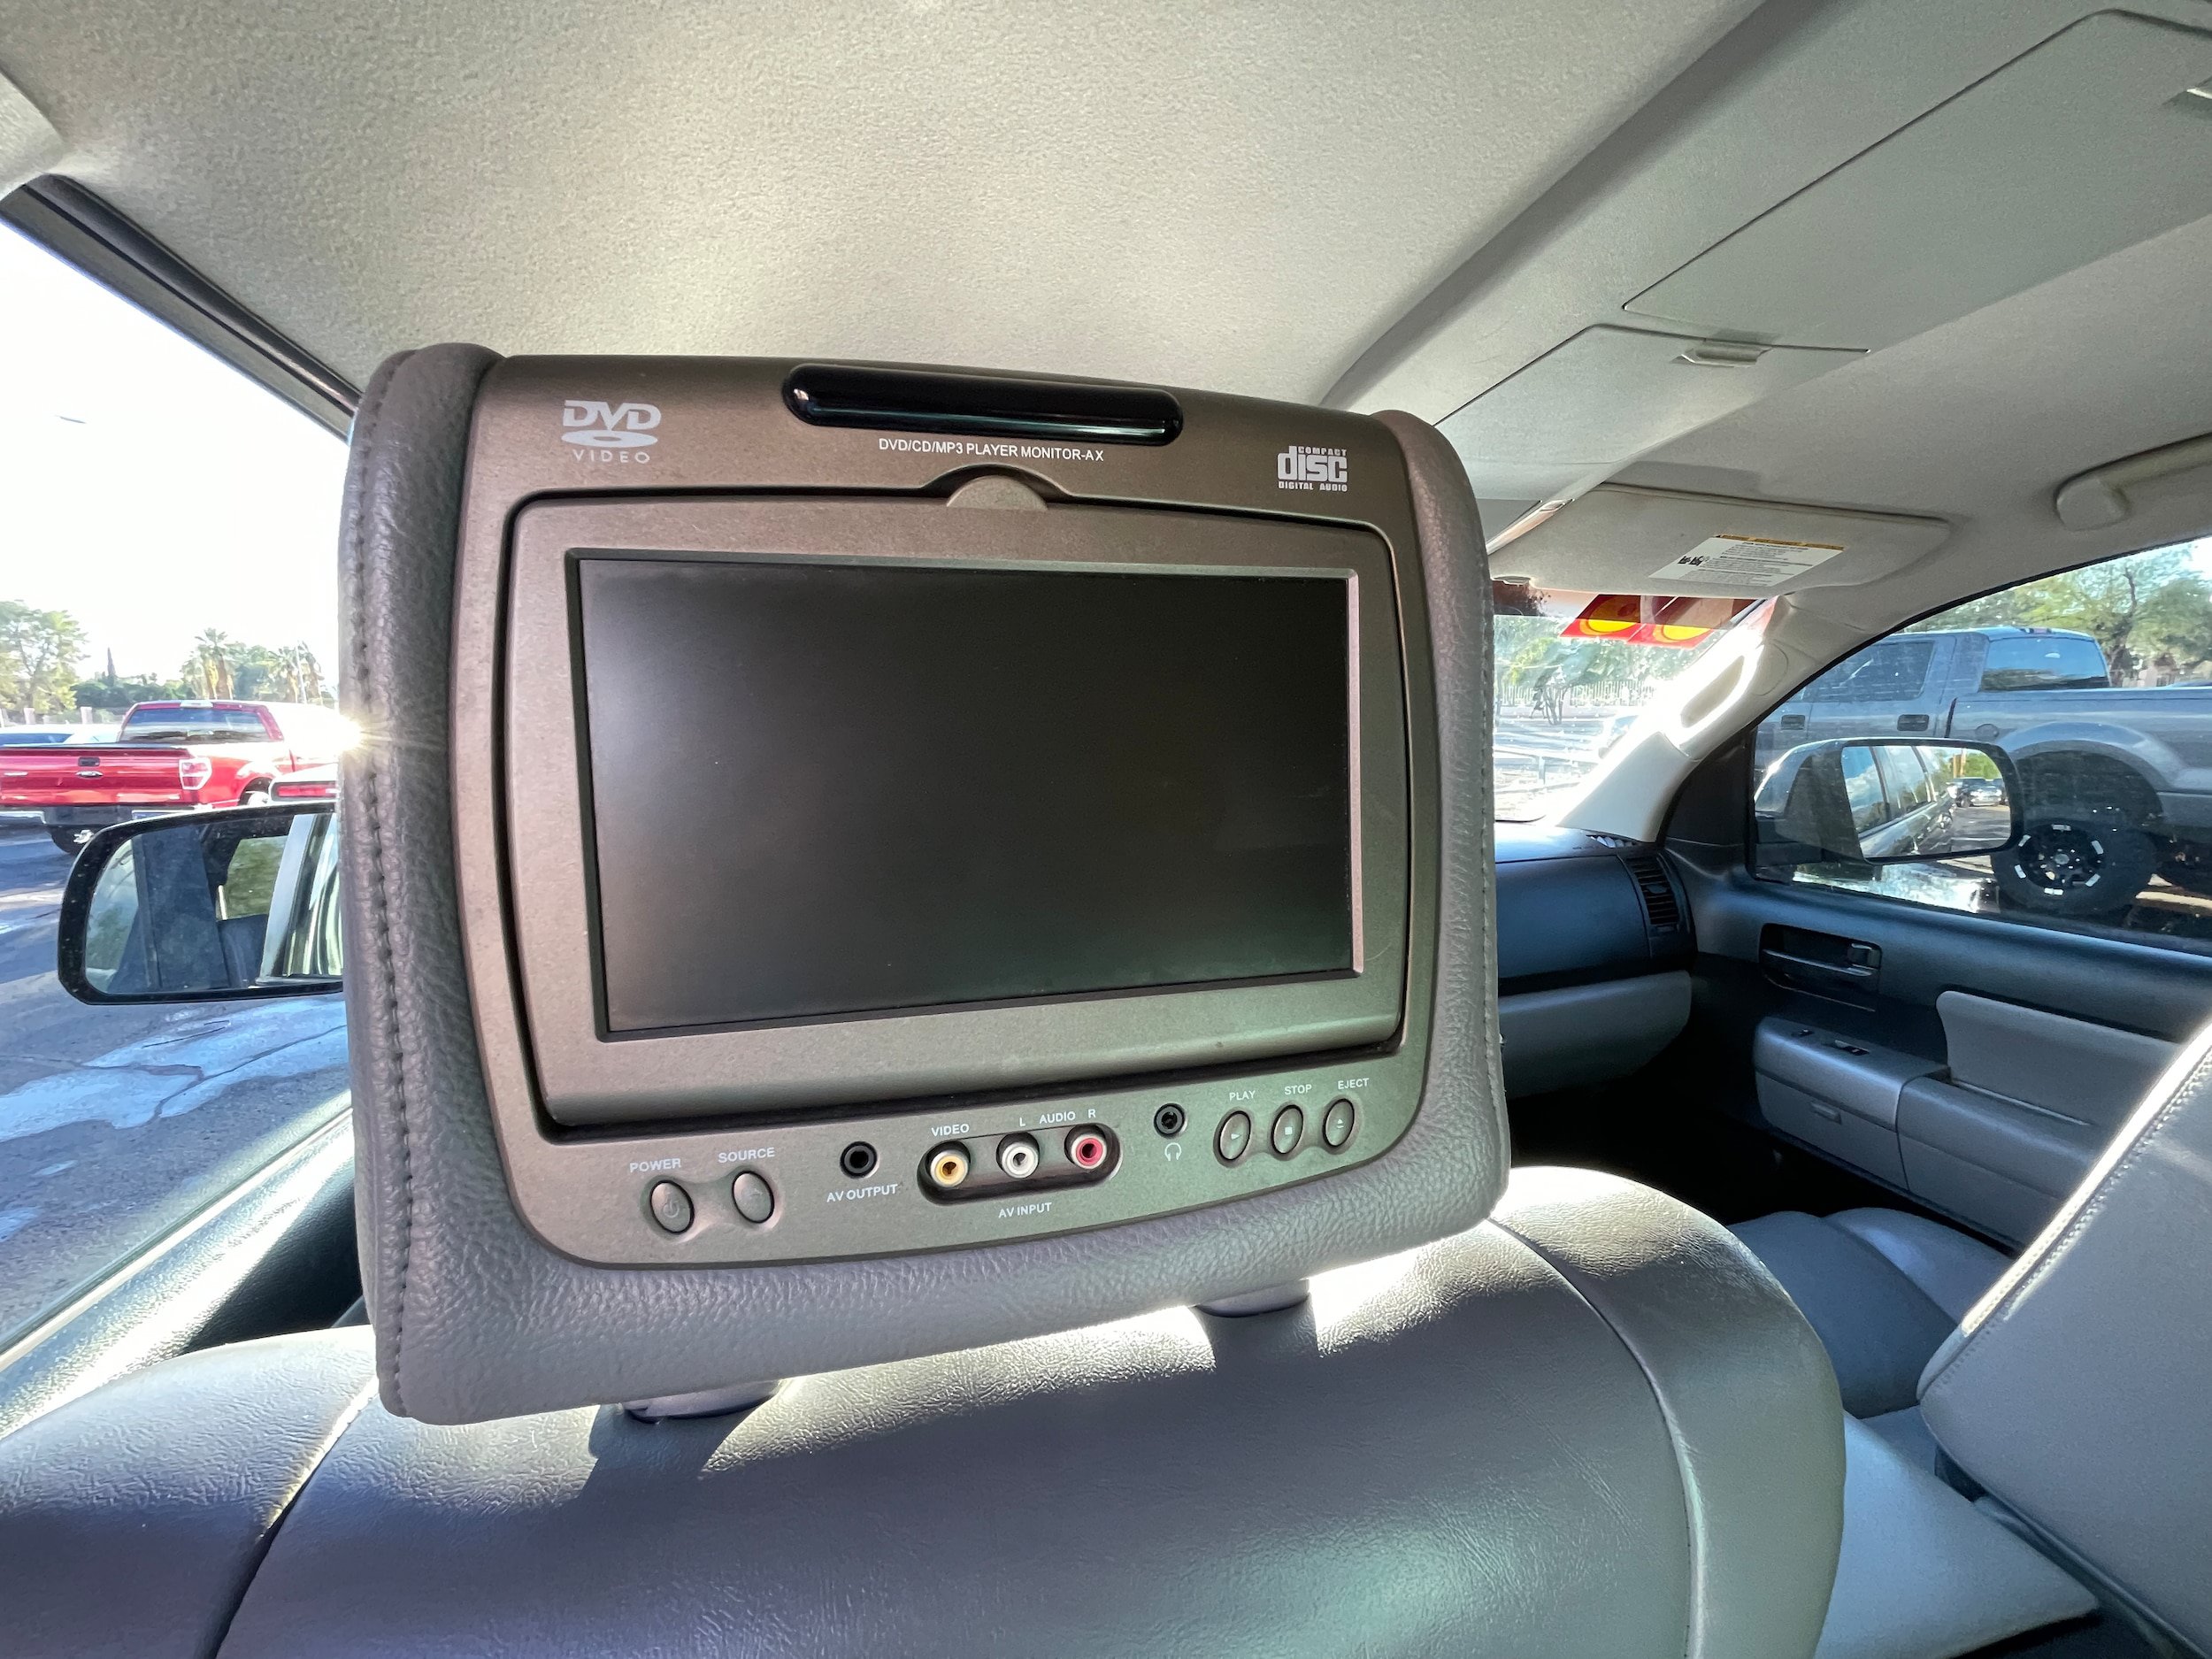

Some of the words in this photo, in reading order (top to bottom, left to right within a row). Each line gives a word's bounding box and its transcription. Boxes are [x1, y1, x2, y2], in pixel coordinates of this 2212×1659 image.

[563, 400, 661, 431] DVD
[572, 449, 650, 464] VIDEO
[879, 438, 964, 455] DVD/CD/MP3
[966, 443, 1018, 457] PLAYER
[1021, 447, 1104, 461] MONITOR-AX
[1298, 446, 1347, 456] COMPACT
[1278, 481, 1314, 490] DIGITAL
[1319, 483, 1348, 492] AUDIO
[1285, 1084, 1312, 1095] STOP
[1338, 1078, 1370, 1089] EJECT
[1229, 1090, 1256, 1102] PLAY
[1019, 1118, 1025, 1127] L
[1039, 1111, 1076, 1125] AUDIO
[1087, 1109, 1096, 1118] R
[931, 1124, 970, 1137] VIDEO
[718, 1147, 775, 1164] SOURCE
[630, 1157, 681, 1172] POWER
[826, 1190, 844, 1202] AV
[846, 1184, 898, 1200] OUTPUT
[998, 1207, 1014, 1218] AV
[1017, 1202, 1052, 1216] INPUT
